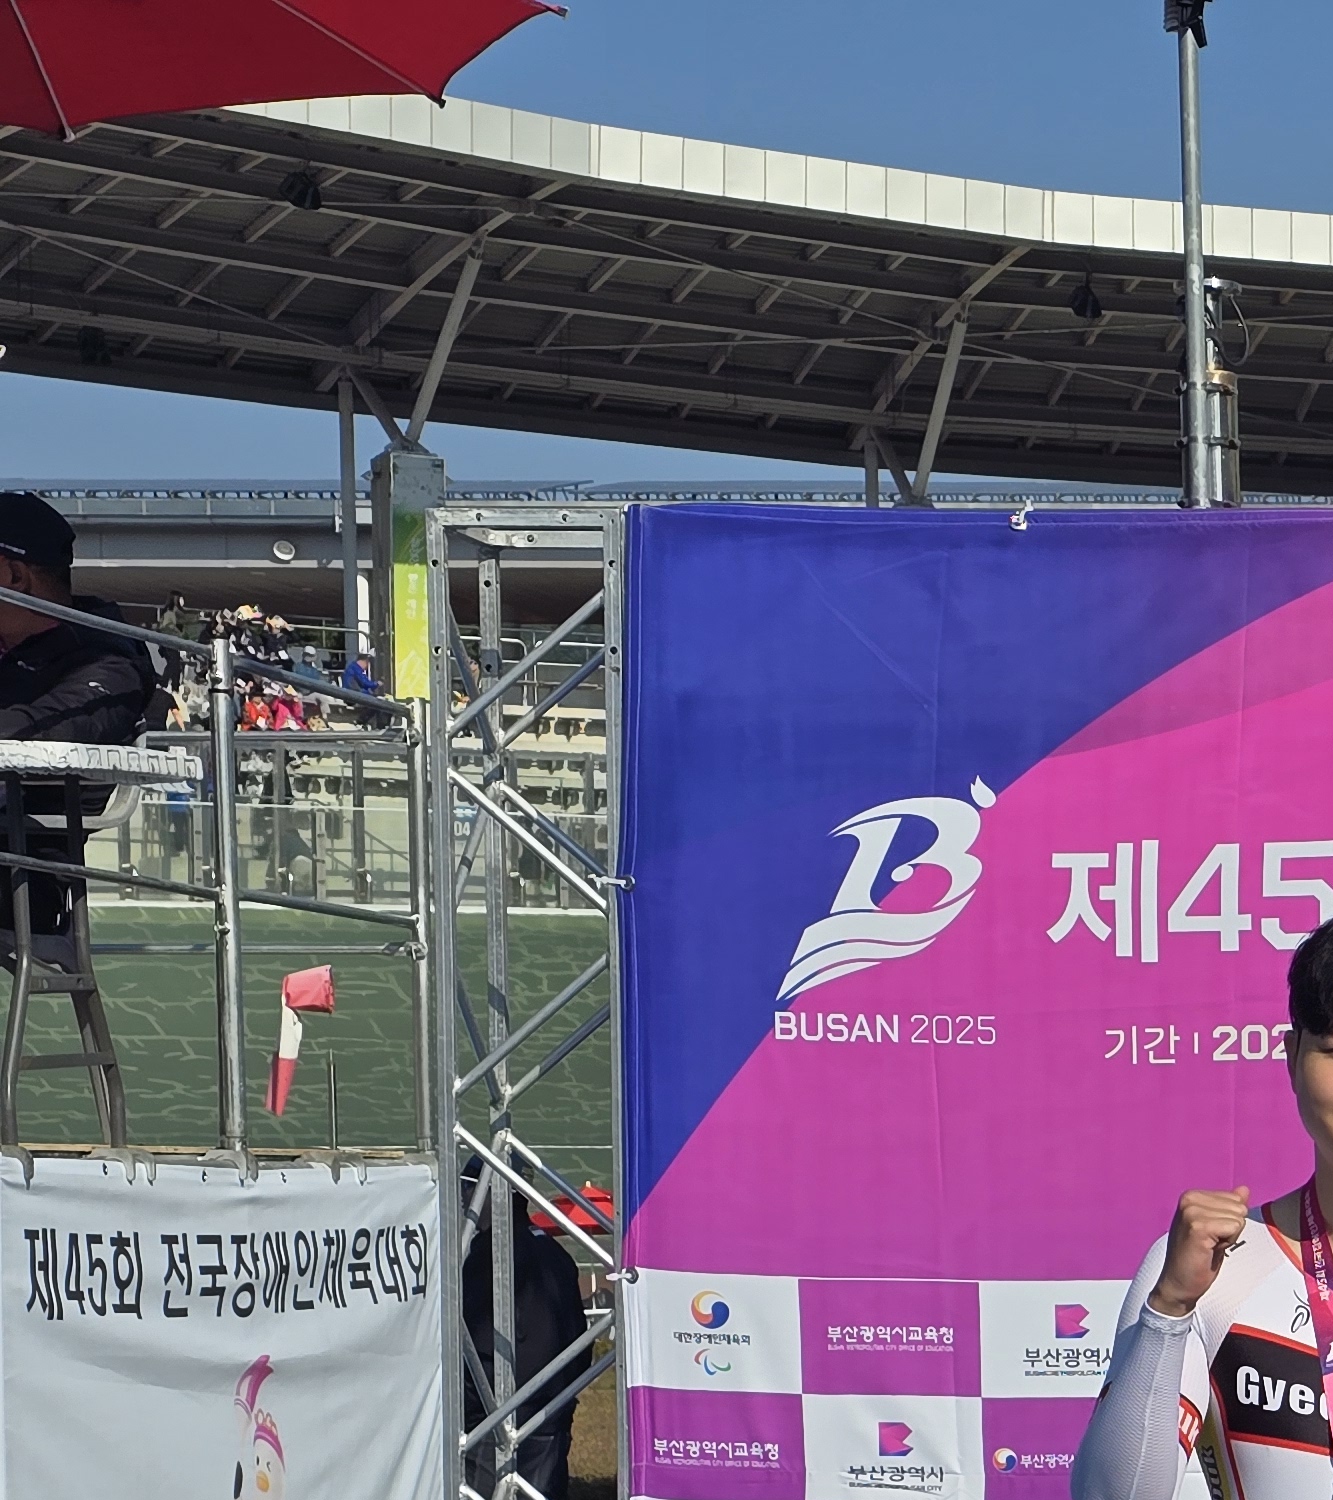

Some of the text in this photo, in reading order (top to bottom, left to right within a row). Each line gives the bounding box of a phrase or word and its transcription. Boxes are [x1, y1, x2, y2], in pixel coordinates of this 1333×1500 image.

[773, 1011, 998, 1046] BUSAN 2025
[1103, 1025, 1178, 1066] 기간
[1211, 1024, 1292, 1063] 202
[23, 1223, 429, 1321] 제45회 전국장애인체육대회
[826, 1324, 954, 1345] 부산광역시교육청
[652, 1438, 780, 1459] 부산광역시교육청
